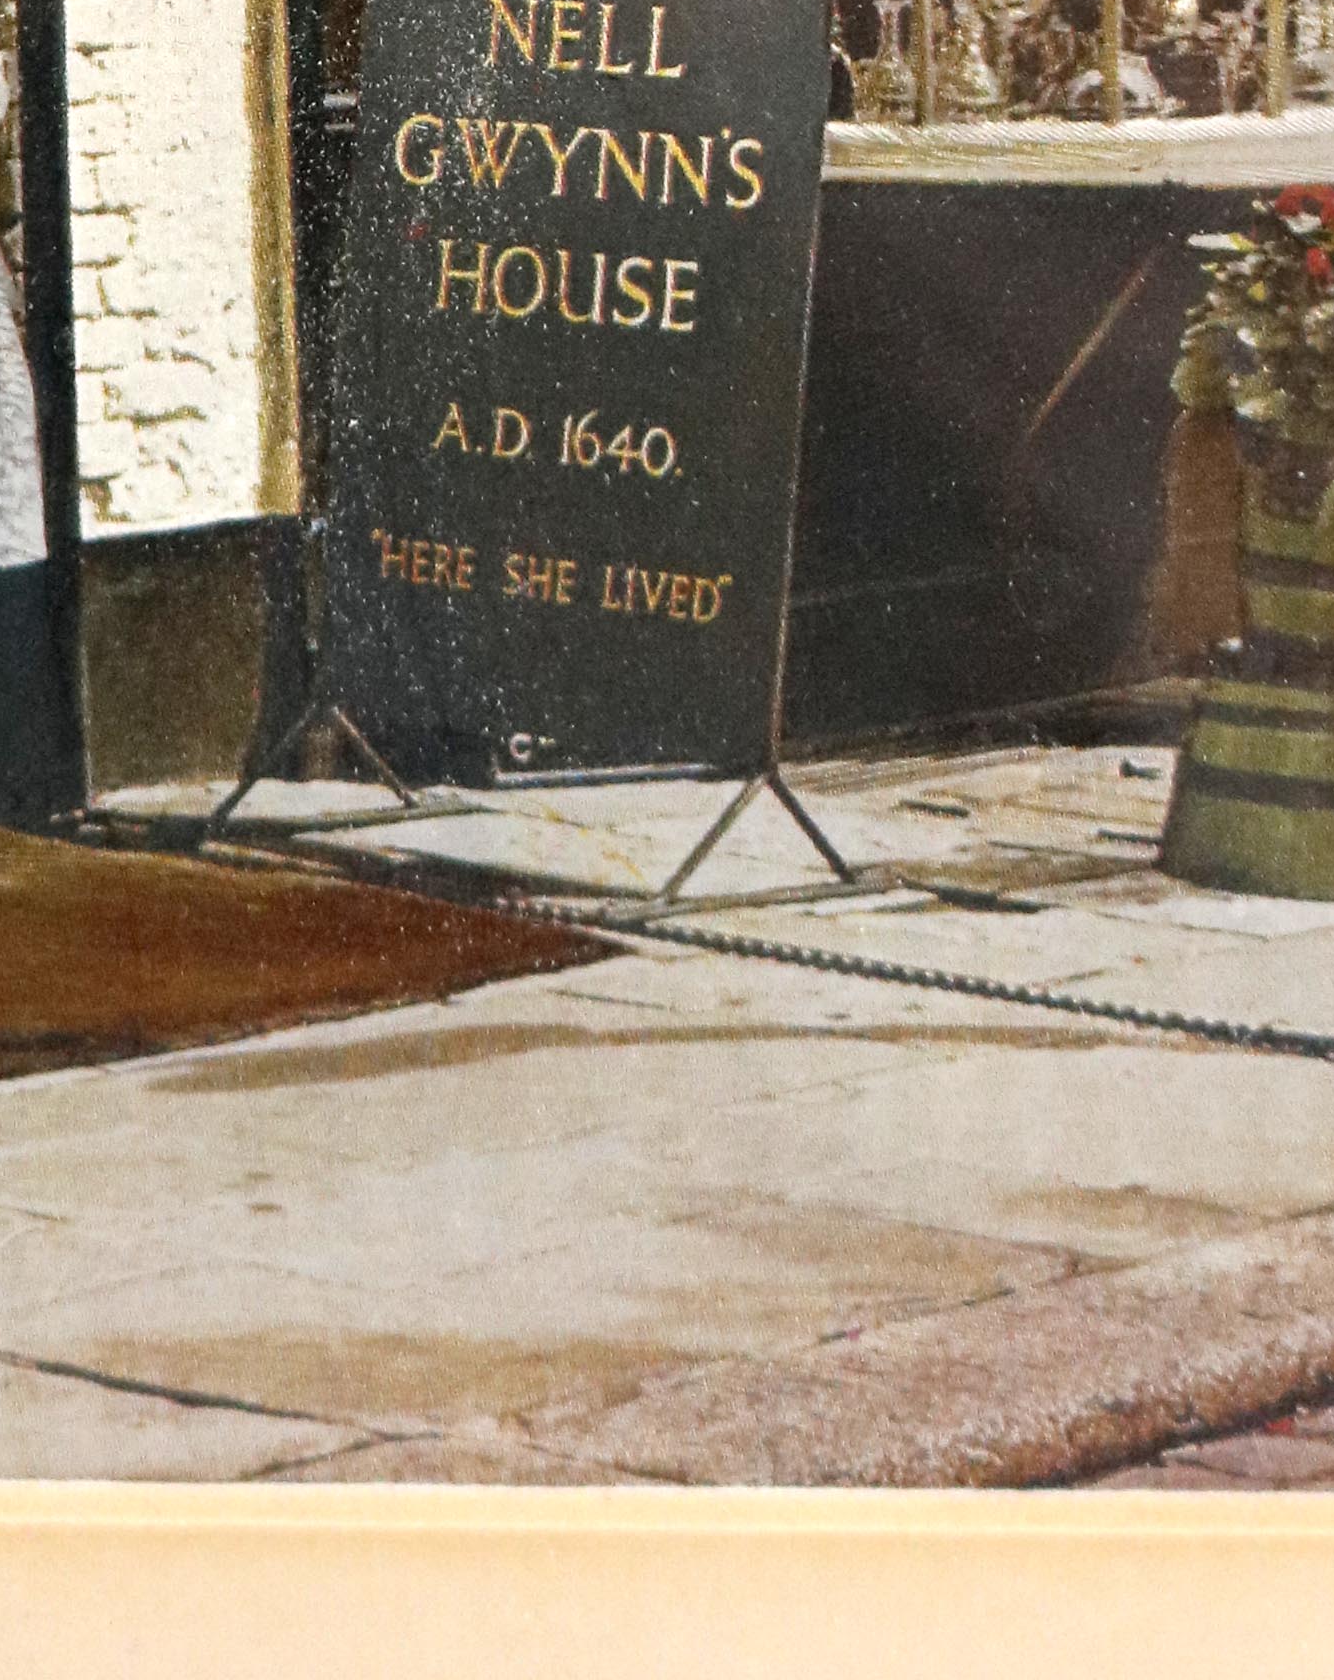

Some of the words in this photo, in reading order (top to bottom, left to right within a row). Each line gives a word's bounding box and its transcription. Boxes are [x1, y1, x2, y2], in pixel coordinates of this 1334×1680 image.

[395, 112, 764, 210] GWYNN'S
[436, 239, 700, 332] HOUSE
[503, 552, 578, 605] SHE
